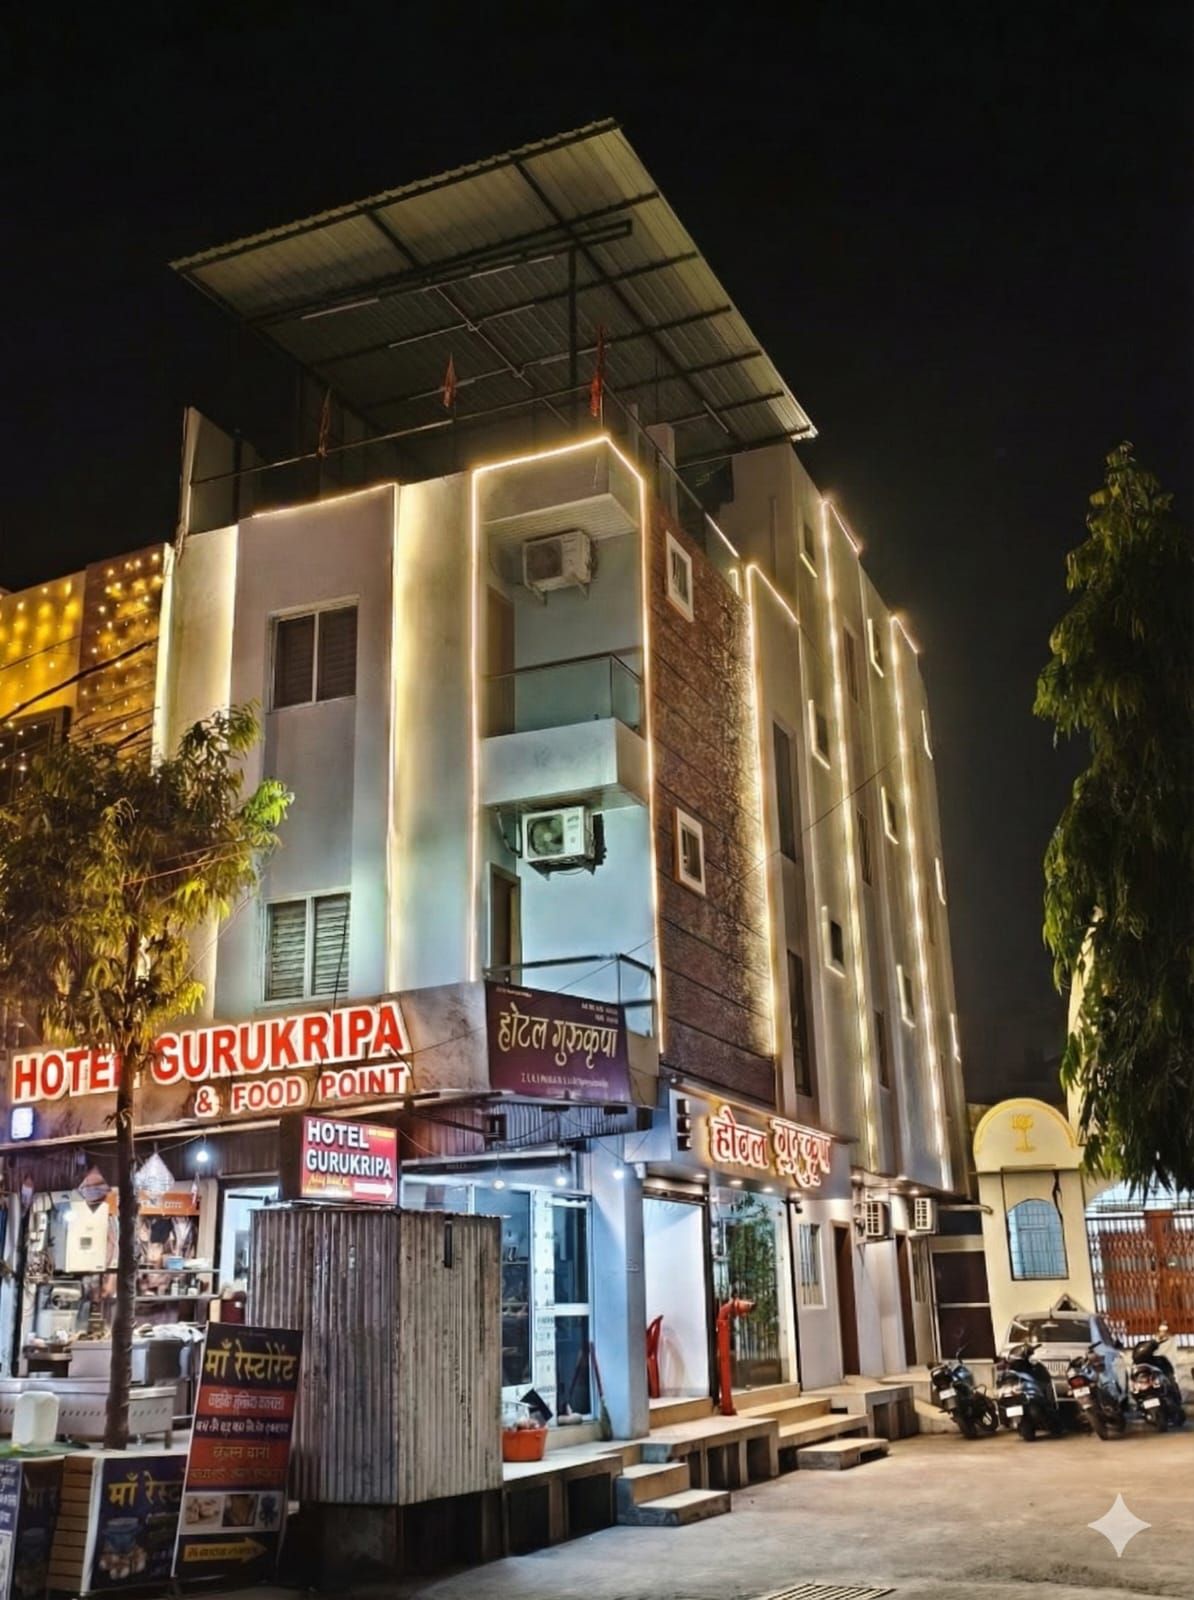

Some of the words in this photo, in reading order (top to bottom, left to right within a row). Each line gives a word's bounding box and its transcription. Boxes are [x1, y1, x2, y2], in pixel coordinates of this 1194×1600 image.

[151, 1002, 409, 1084] GURUKRIPA
[498, 1001, 549, 1051] होटल
[552, 1019, 618, 1069] गुरुकृपा
[195, 1085, 218, 1117] &
[231, 1076, 307, 1114] FOOD
[320, 1062, 410, 1101] POINT
[307, 1120, 369, 1149] HOTEL
[306, 1148, 392, 1179] GURUKRIPA
[205, 1338, 232, 1378] माँ
[108, 1472, 138, 1507] माँ
